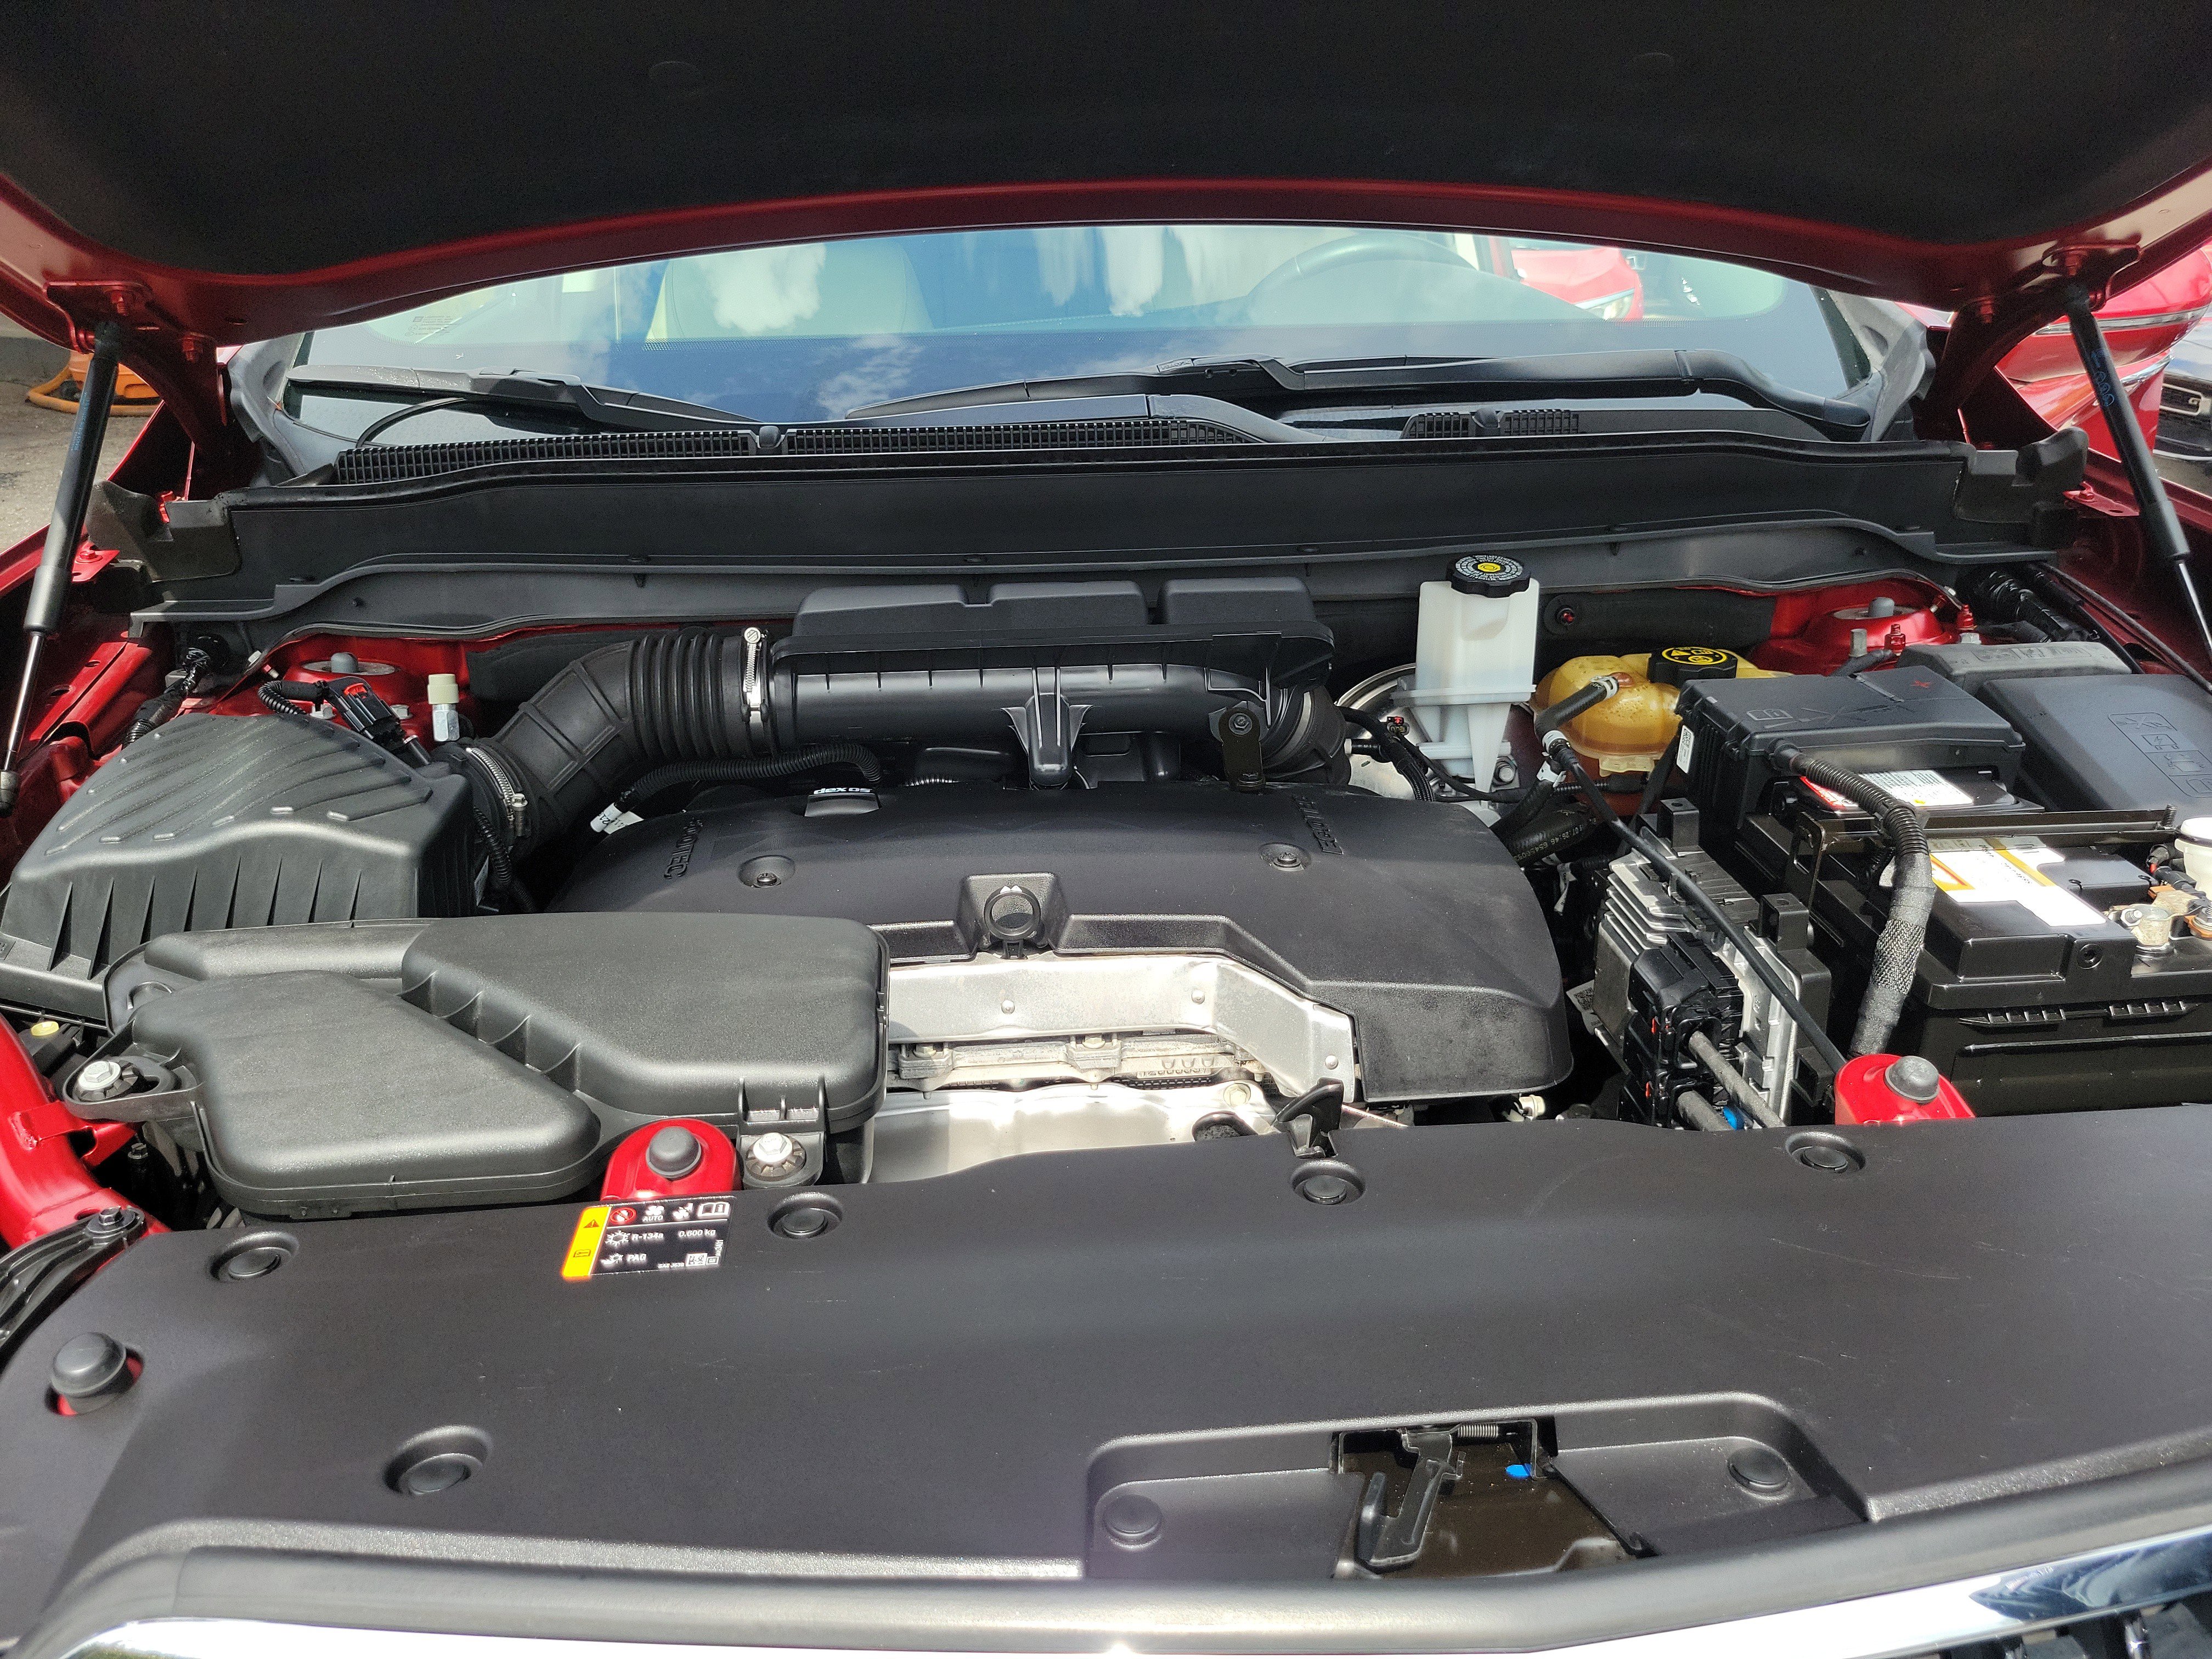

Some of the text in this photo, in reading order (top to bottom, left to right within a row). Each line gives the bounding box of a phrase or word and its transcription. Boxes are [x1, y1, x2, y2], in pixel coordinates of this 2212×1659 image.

[664, 817, 703, 879] ECOTEC
[631, 1232, 664, 1241] R-134a
[679, 1229, 703, 1237] 0.600
[627, 1253, 647, 1262] PAG
